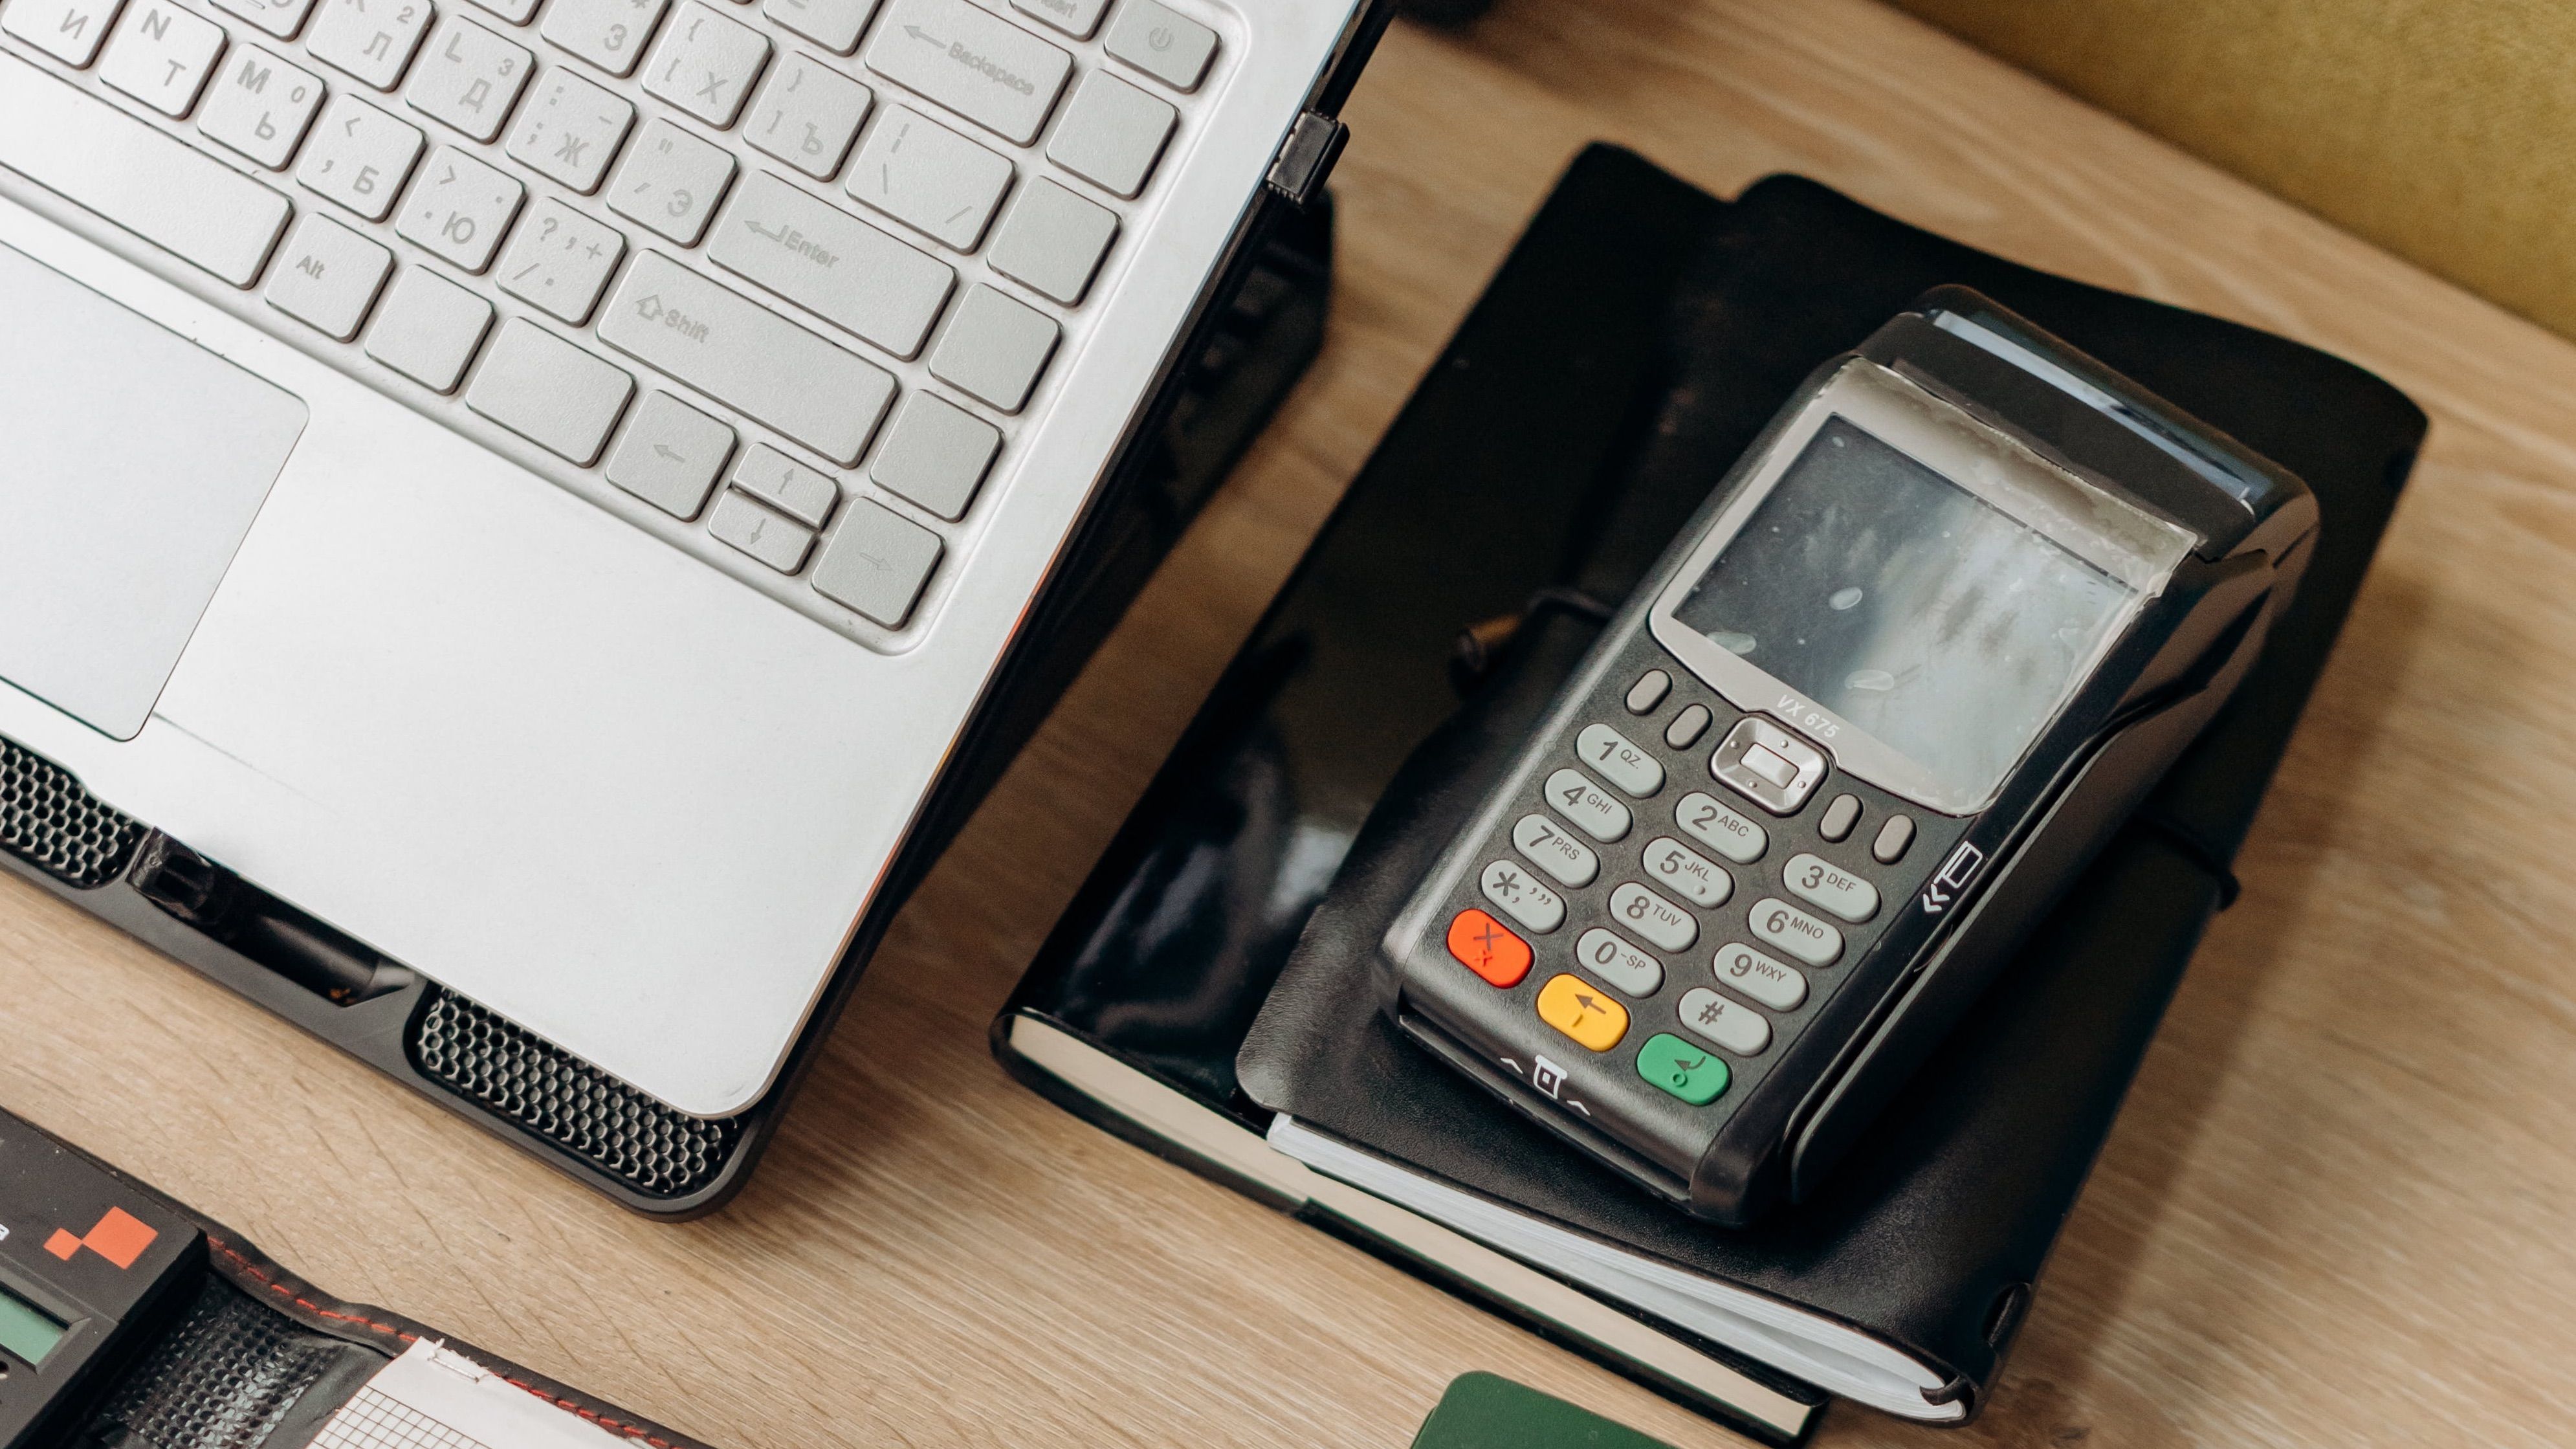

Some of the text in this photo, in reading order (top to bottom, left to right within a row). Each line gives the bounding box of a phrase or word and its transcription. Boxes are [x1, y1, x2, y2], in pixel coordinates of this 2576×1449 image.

[60, 8, 89, 39] И
[140, 8, 171, 41] N
[396, 5, 415, 25] 2
[362, 30, 393, 62] Л
[444, 32, 462, 63] L
[604, 23, 628, 51] З
[164, 59, 187, 87] Т
[237, 60, 272, 94] M
[498, 58, 515, 78] 3
[948, 41, 1035, 96] Backspace
[458, 78, 492, 114] Д
[696, 71, 729, 105] Х
[254, 111, 276, 141] Ь
[800, 122, 824, 156] Ъ
[554, 132, 589, 168] Ж
[353, 165, 380, 195] Б
[667, 188, 694, 217] Э
[441, 210, 476, 245] Ю
[784, 230, 840, 269] Enter
[296, 255, 325, 280] Alt
[665, 309, 710, 344] Shift
[1776, 694, 1840, 740] VX 675
[1602, 740, 1619, 762] 1
[1563, 786, 1613, 815] 4 GHI
[1691, 805, 1750, 839] 2 ABC
[1529, 825, 1580, 861] 7 PRS
[1660, 850, 1710, 883] 5 JKL
[1801, 865, 1857, 894] 3 DEF
[1626, 896, 1682, 927] 8 TUV
[1767, 910, 1825, 940] 6 MNO
[1594, 941, 1617, 964] 0
[1730, 953, 1787, 983] 9 WXY
[1698, 1001, 1724, 1025] #
